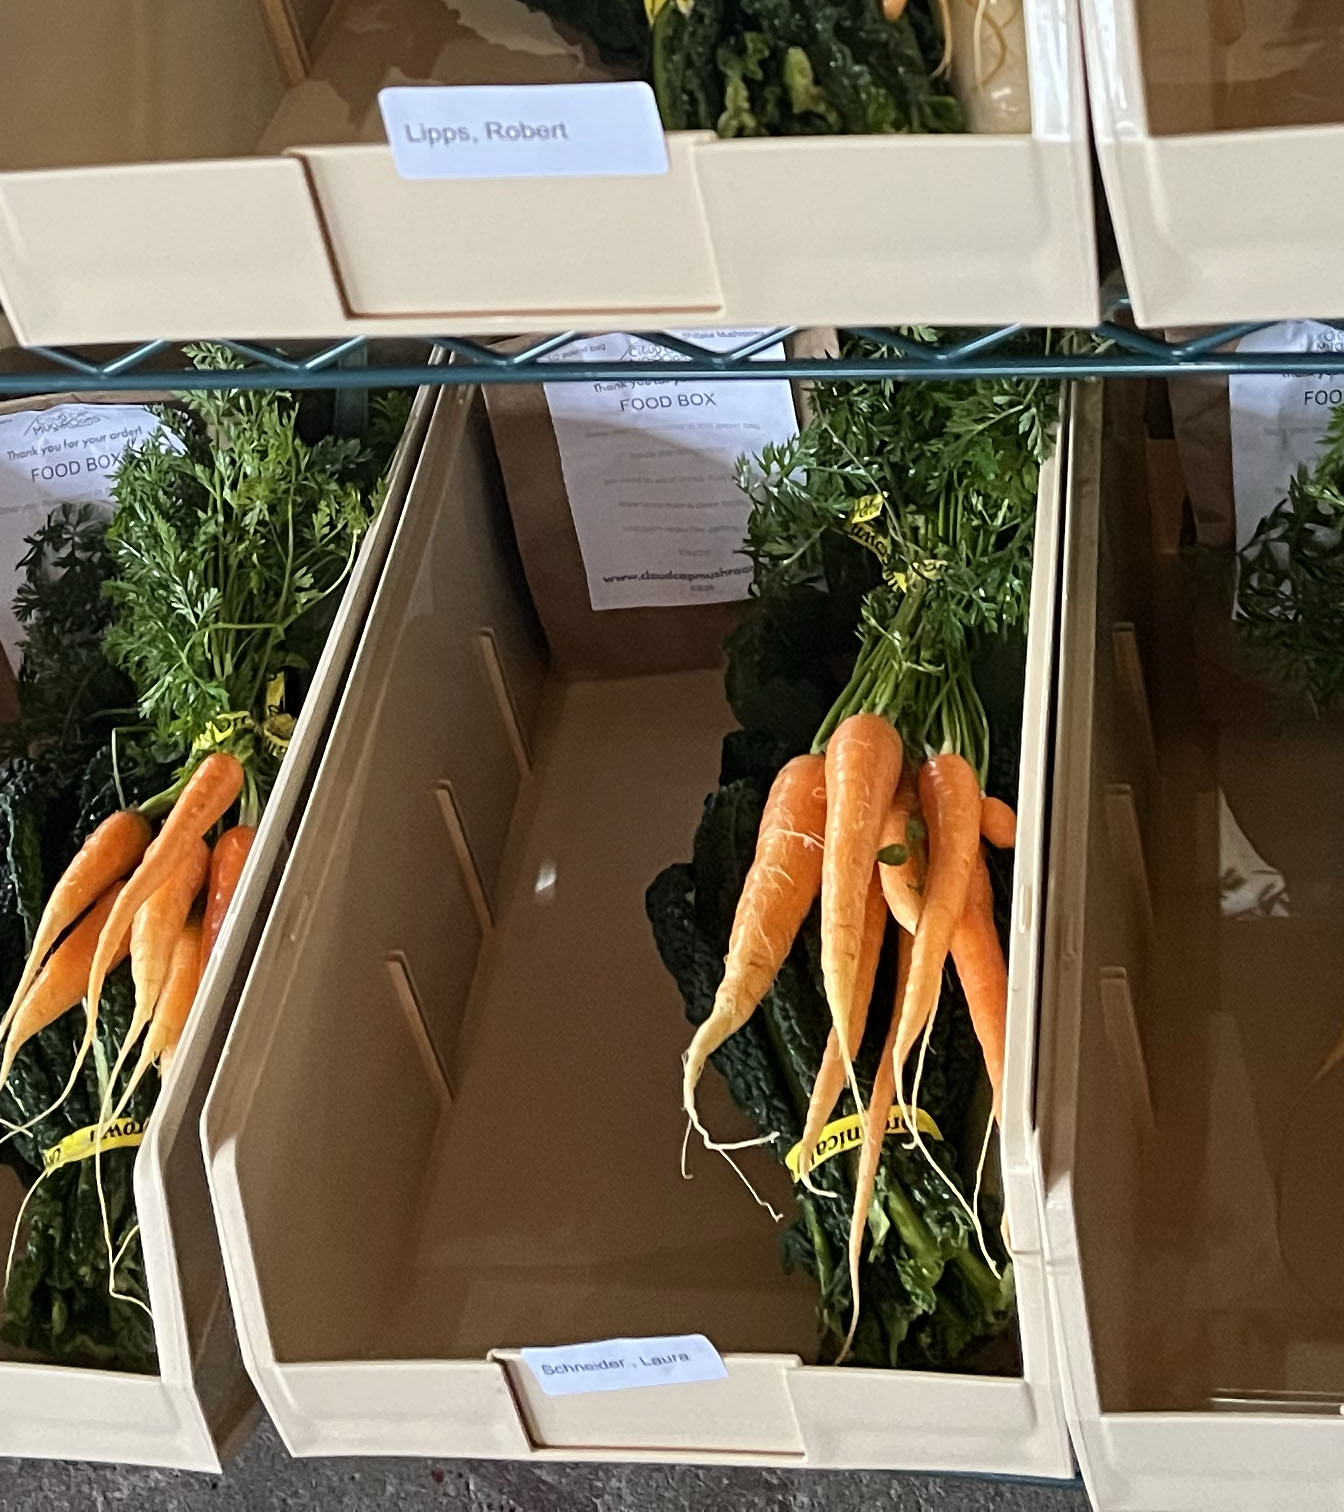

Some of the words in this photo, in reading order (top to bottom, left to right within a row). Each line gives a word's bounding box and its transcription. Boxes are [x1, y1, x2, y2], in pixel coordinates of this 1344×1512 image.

[405, 123, 479, 148] Lipps,
[485, 120, 569, 140] Robert
[620, 395, 672, 412] FOOD
[678, 392, 717, 407] BOX
[7, 448, 38, 461] Thank
[41, 443, 61, 456] you
[63, 439, 79, 449] for
[82, 435, 106, 448] your
[31, 460, 81, 483] FOOD
[86, 452, 122, 471] BOX
[541, 1359, 625, 1376] Schneider
[639, 1352, 689, 1367] Laura
